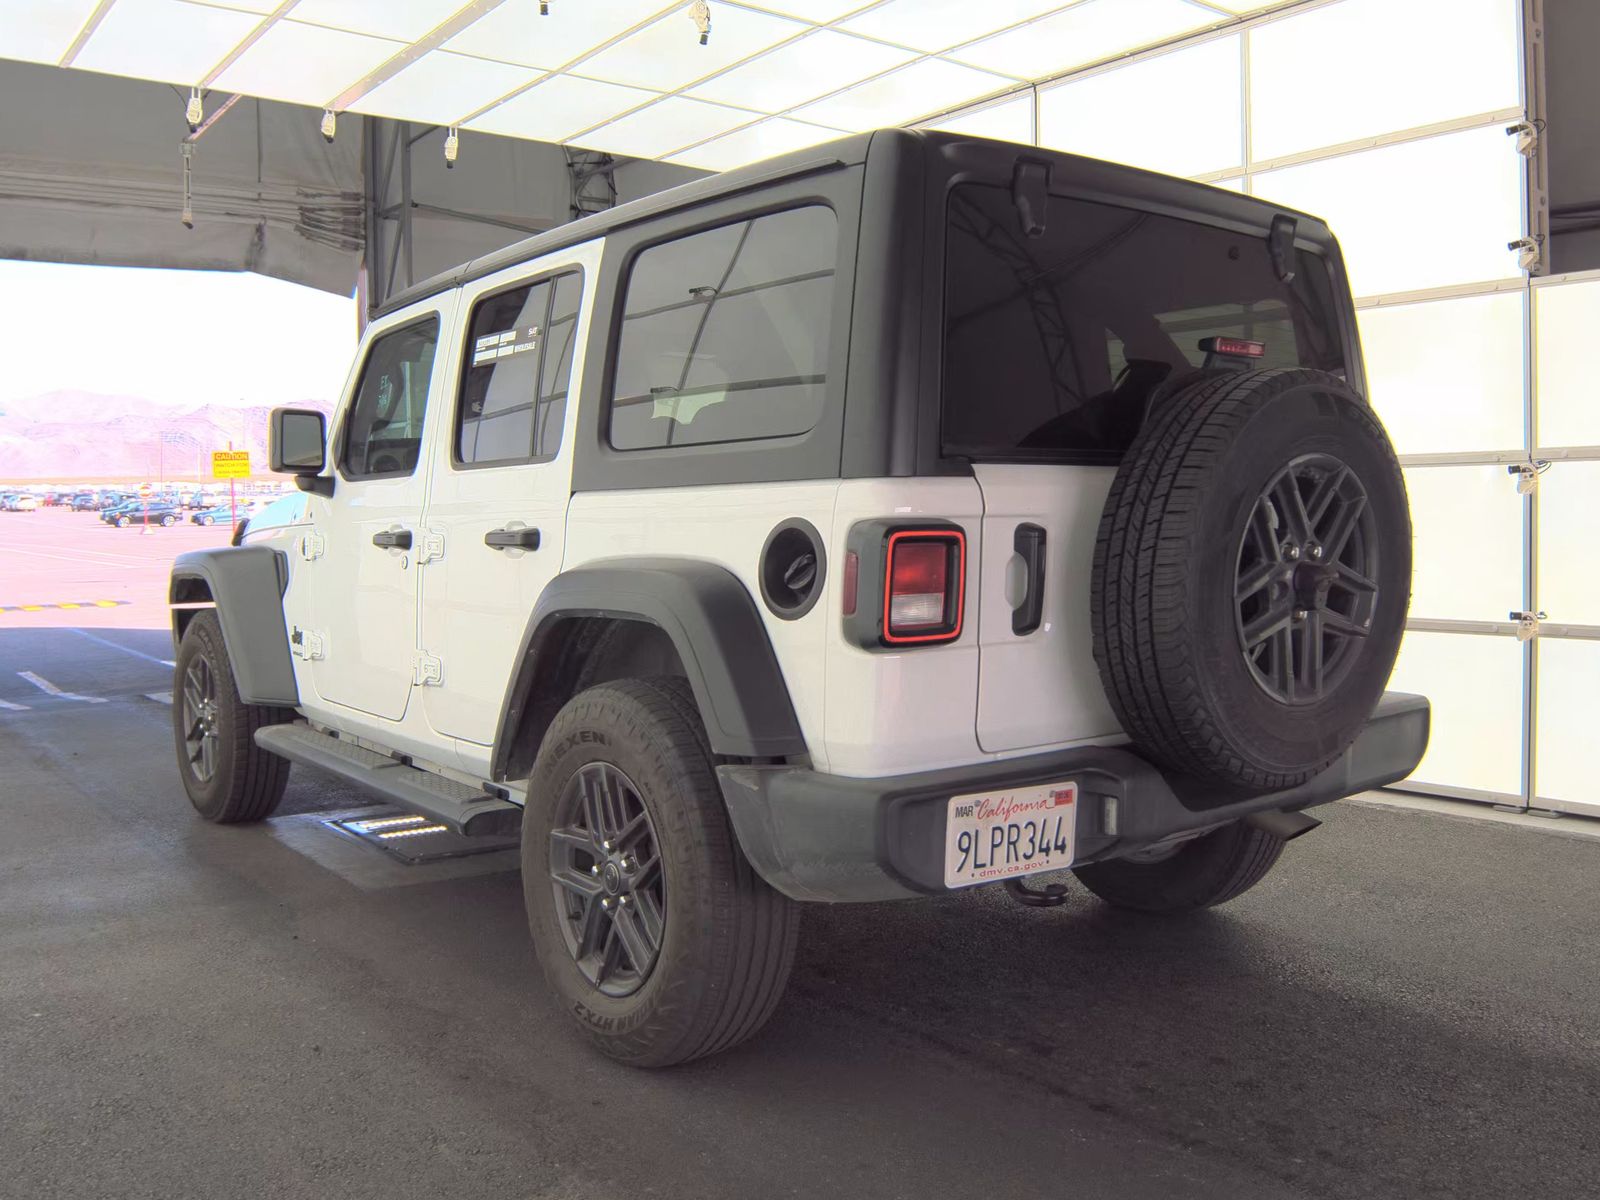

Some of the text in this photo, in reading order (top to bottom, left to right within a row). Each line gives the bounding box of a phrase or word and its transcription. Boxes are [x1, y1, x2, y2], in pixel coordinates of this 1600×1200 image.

[544, 731, 606, 776] NEXEN
[955, 806, 974, 818] MAR
[976, 796, 1055, 822] California
[957, 816, 1067, 873] 9LPR344
[980, 861, 1043, 877] dmv.ca.gov
[574, 1001, 612, 1032] HTX2
